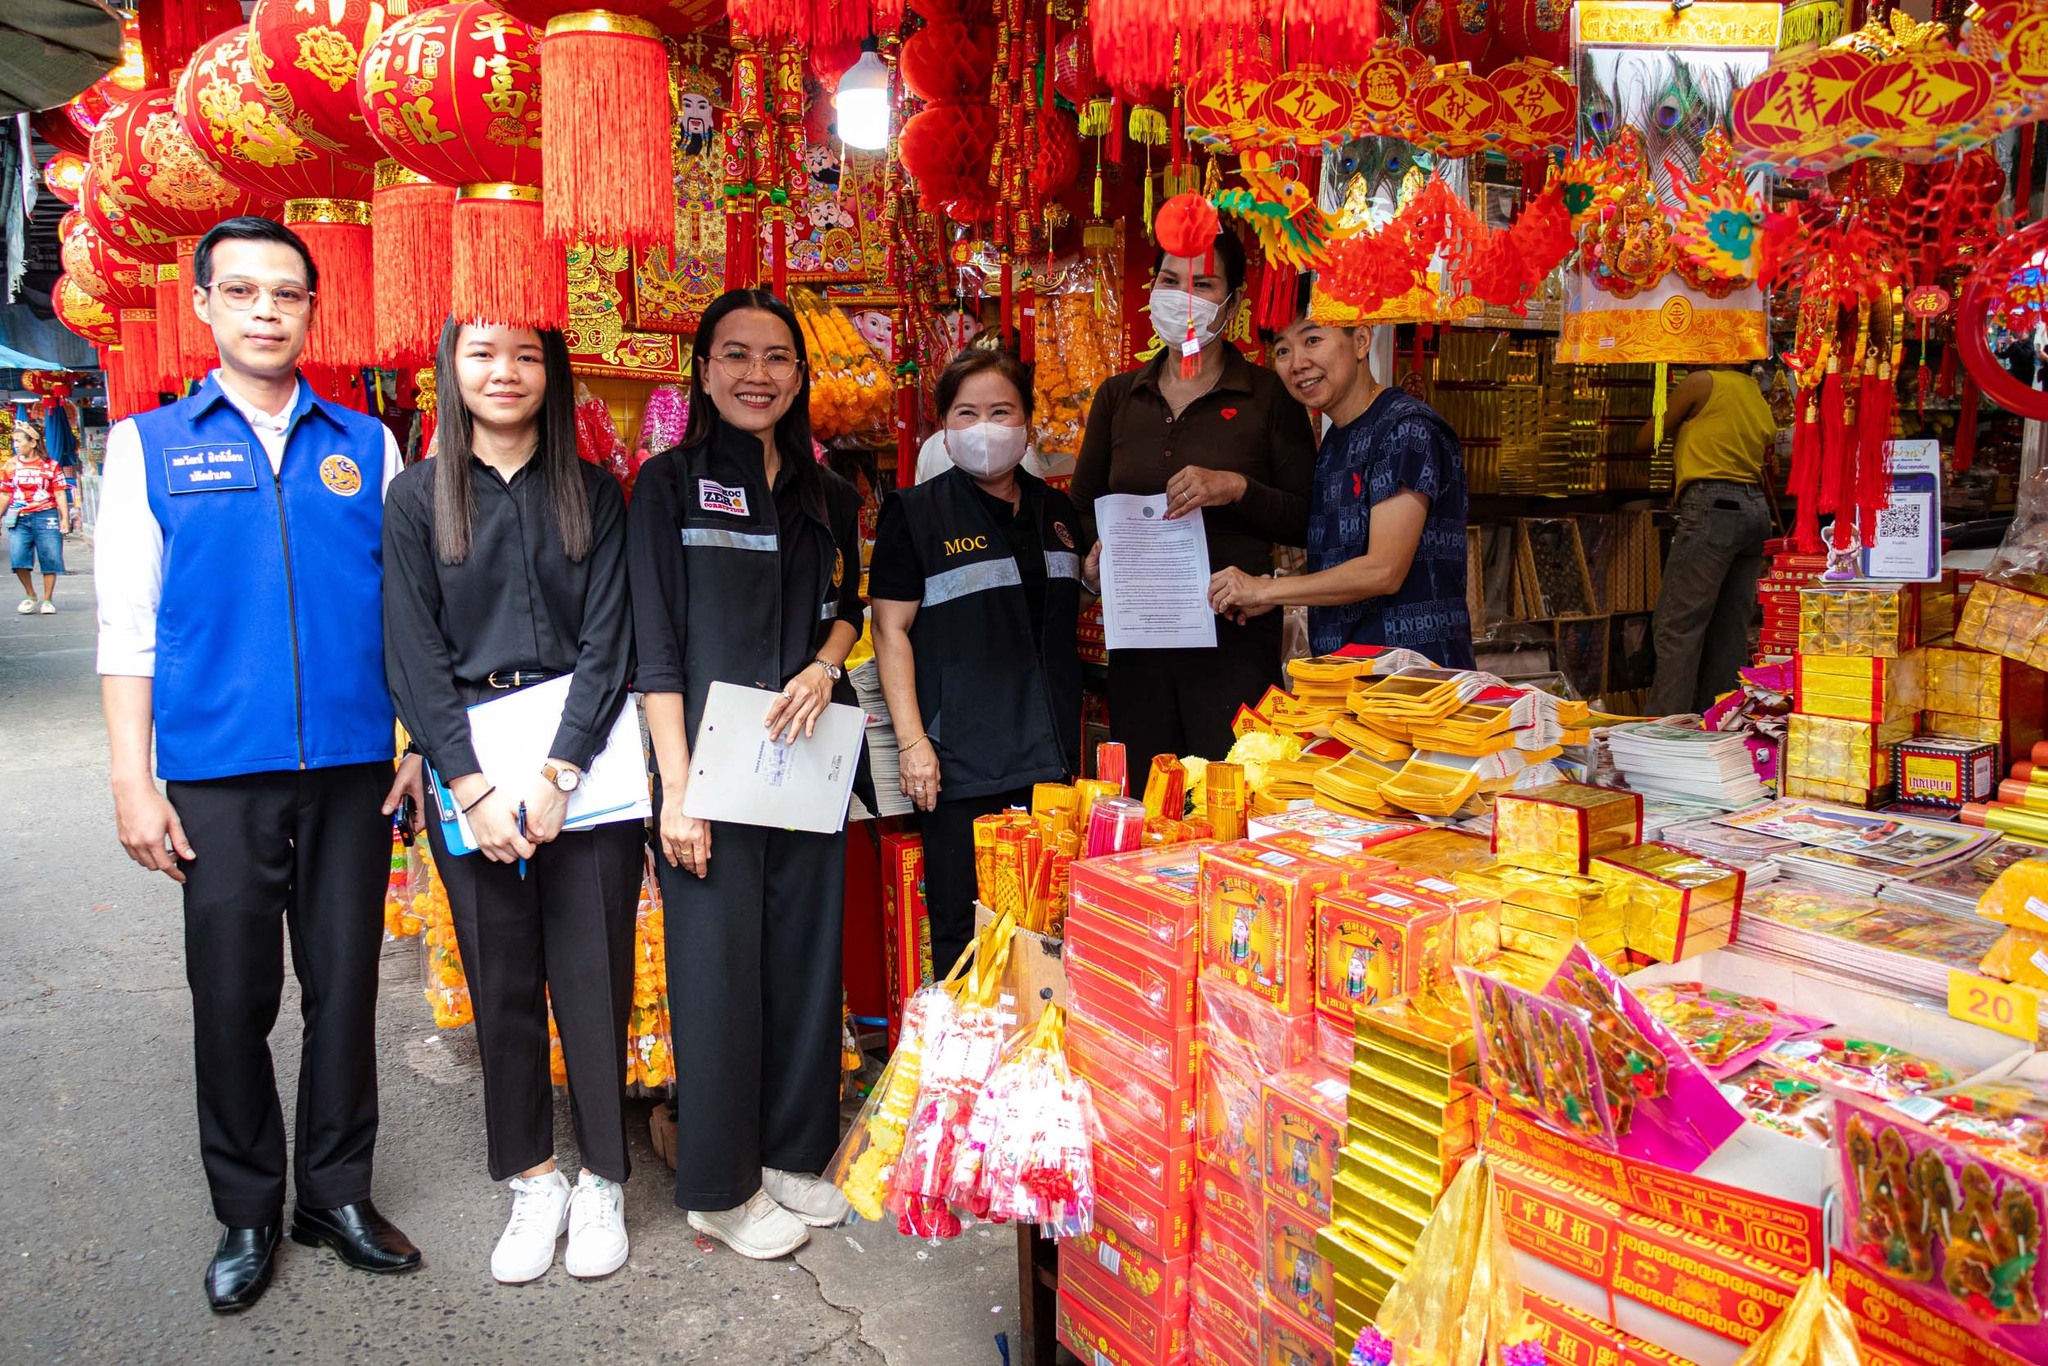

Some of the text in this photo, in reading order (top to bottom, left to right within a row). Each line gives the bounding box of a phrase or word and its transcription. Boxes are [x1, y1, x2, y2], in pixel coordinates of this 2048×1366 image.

[1294, 82, 1326, 123] 龙
[1441, 88, 1476, 122] 献
[1513, 83, 1547, 119] 瑞
[1775, 69, 1947, 127] 祥 龙
[1914, 293, 1939, 312] 福
[704, 502, 745, 514] CORRUPTION
[943, 535, 989, 557] MOC
[1384, 613, 1439, 636] PLAYBOY
[1968, 987, 2013, 1024] 20
[1753, 1226, 1793, 1257] 701
